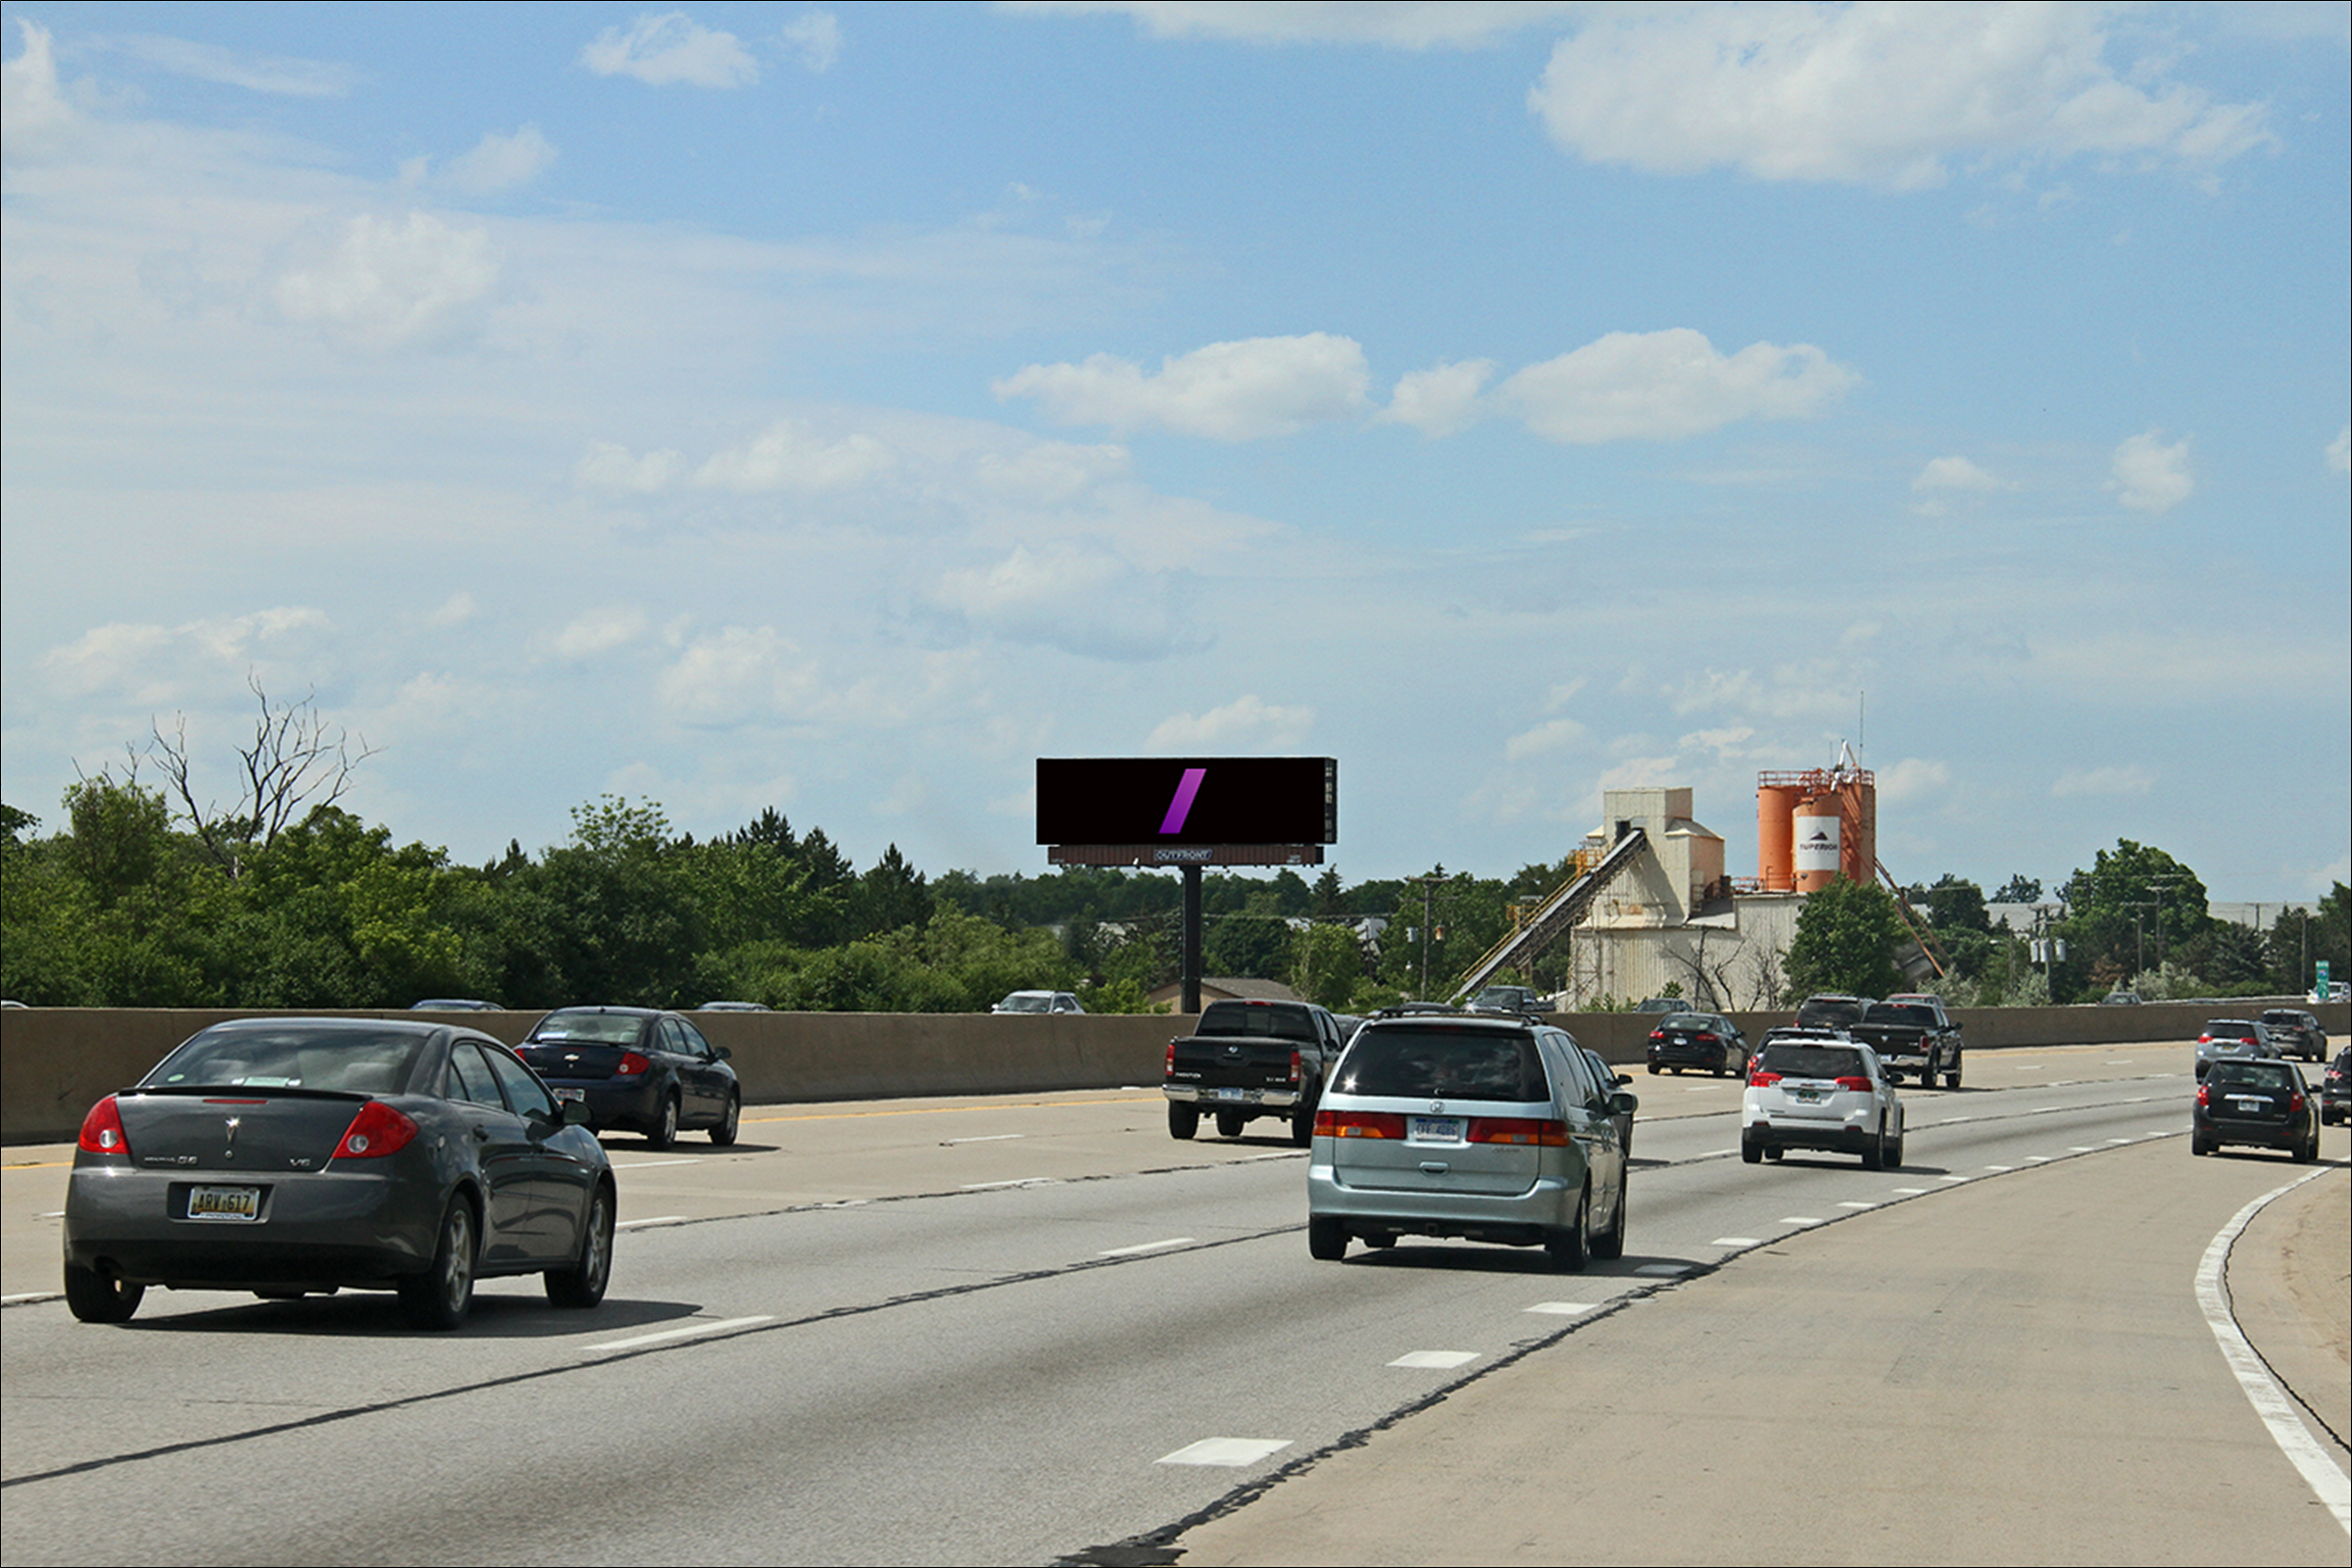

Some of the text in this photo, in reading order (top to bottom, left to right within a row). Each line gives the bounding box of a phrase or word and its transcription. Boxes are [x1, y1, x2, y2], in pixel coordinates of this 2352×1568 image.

[1155, 849, 1213, 860] OUTFRONT
[289, 1157, 311, 1166] V6
[198, 1194, 250, 1211] ARV 617
